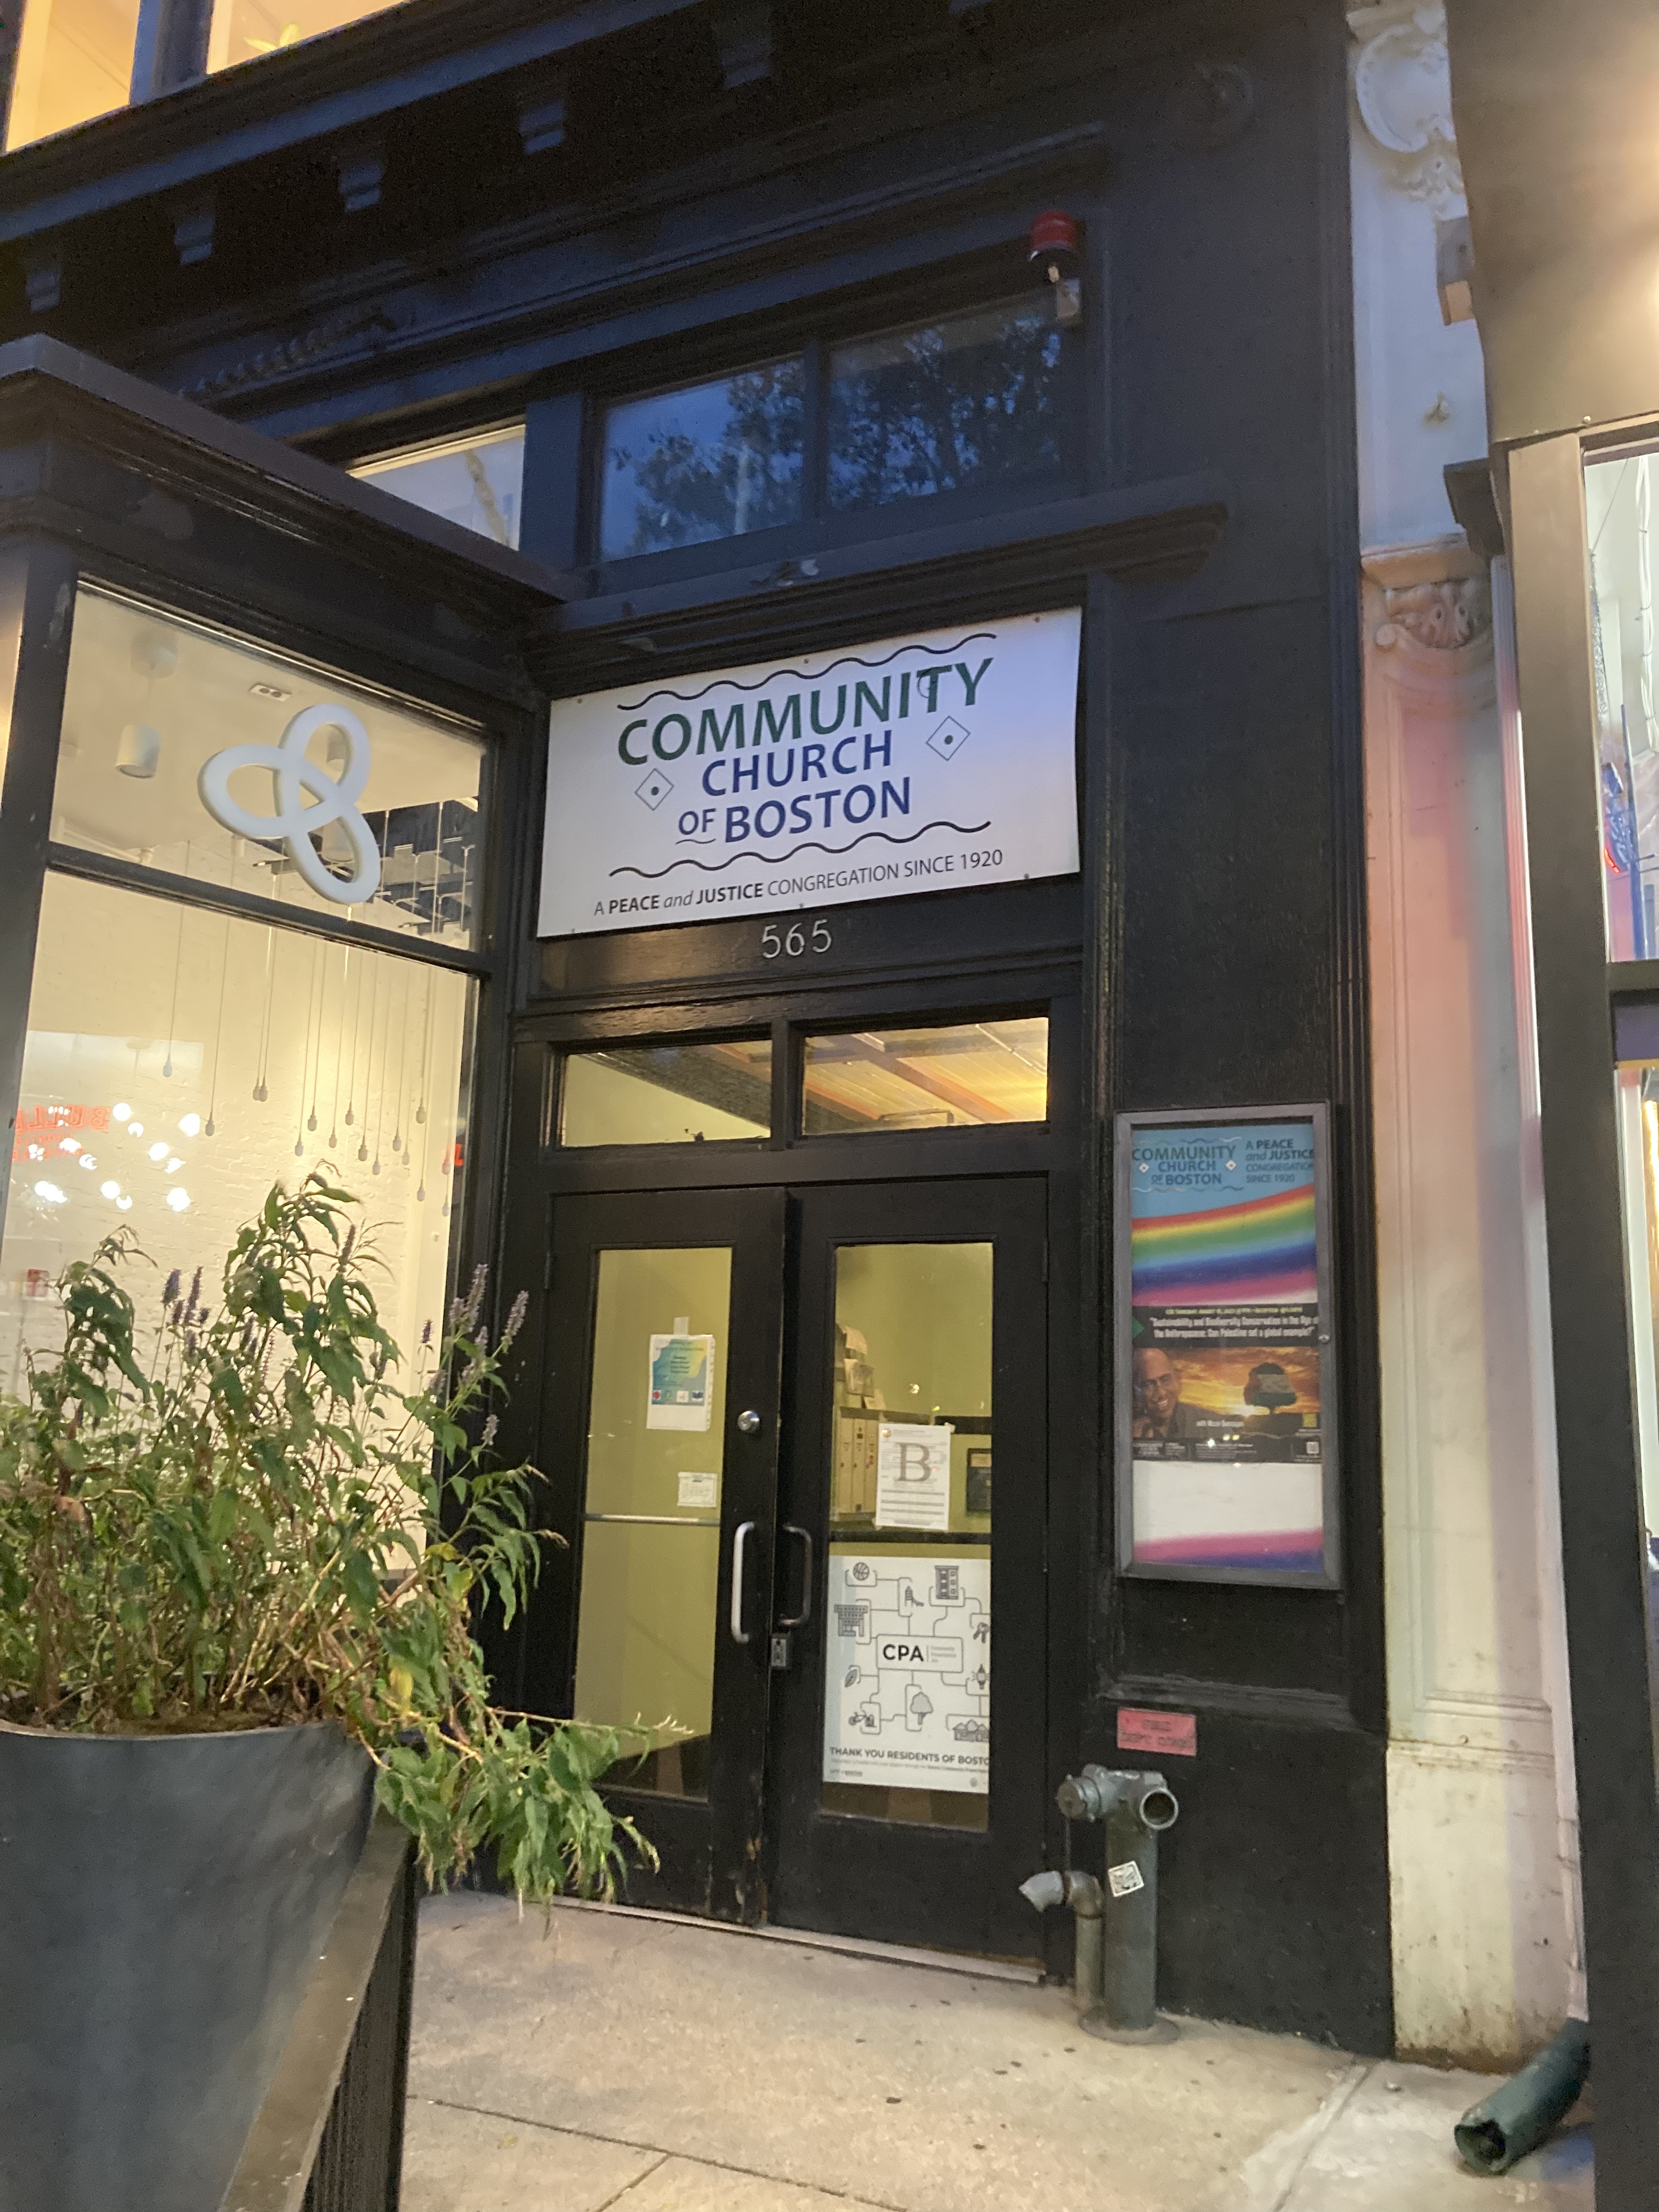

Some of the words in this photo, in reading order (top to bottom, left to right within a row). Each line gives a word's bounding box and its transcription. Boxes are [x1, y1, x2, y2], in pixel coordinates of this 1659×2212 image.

[618, 657, 994, 765] COMMUNITY
[702, 730, 892, 797] CHURCH
[678, 808, 716, 835] OF
[725, 776, 911, 843] BOSTON
[594, 901, 605, 916] A
[608, 894, 661, 914] PEACE
[663, 890, 694, 908] and
[696, 882, 764, 905] JUSTICE
[768, 863, 899, 896] CONGREGATION
[904, 855, 955, 877] SINCE
[960, 849, 1003, 870] 1920
[761, 918, 833, 959] 565
[1132, 1144, 1237, 1161] COMMUNITY
[1256, 1138, 1294, 1149] PEACE
[1157, 1160, 1216, 1172] CHURCH
[1165, 1173, 1222, 1186] BOSTON
[894, 1442, 932, 1482] B
[883, 1644, 924, 1662] CPA
[829, 1747, 862, 1756] THANK
[864, 1748, 884, 1758] YOU
[887, 1750, 940, 1762] RESIDENTS
[942, 1754, 955, 1763] OF
